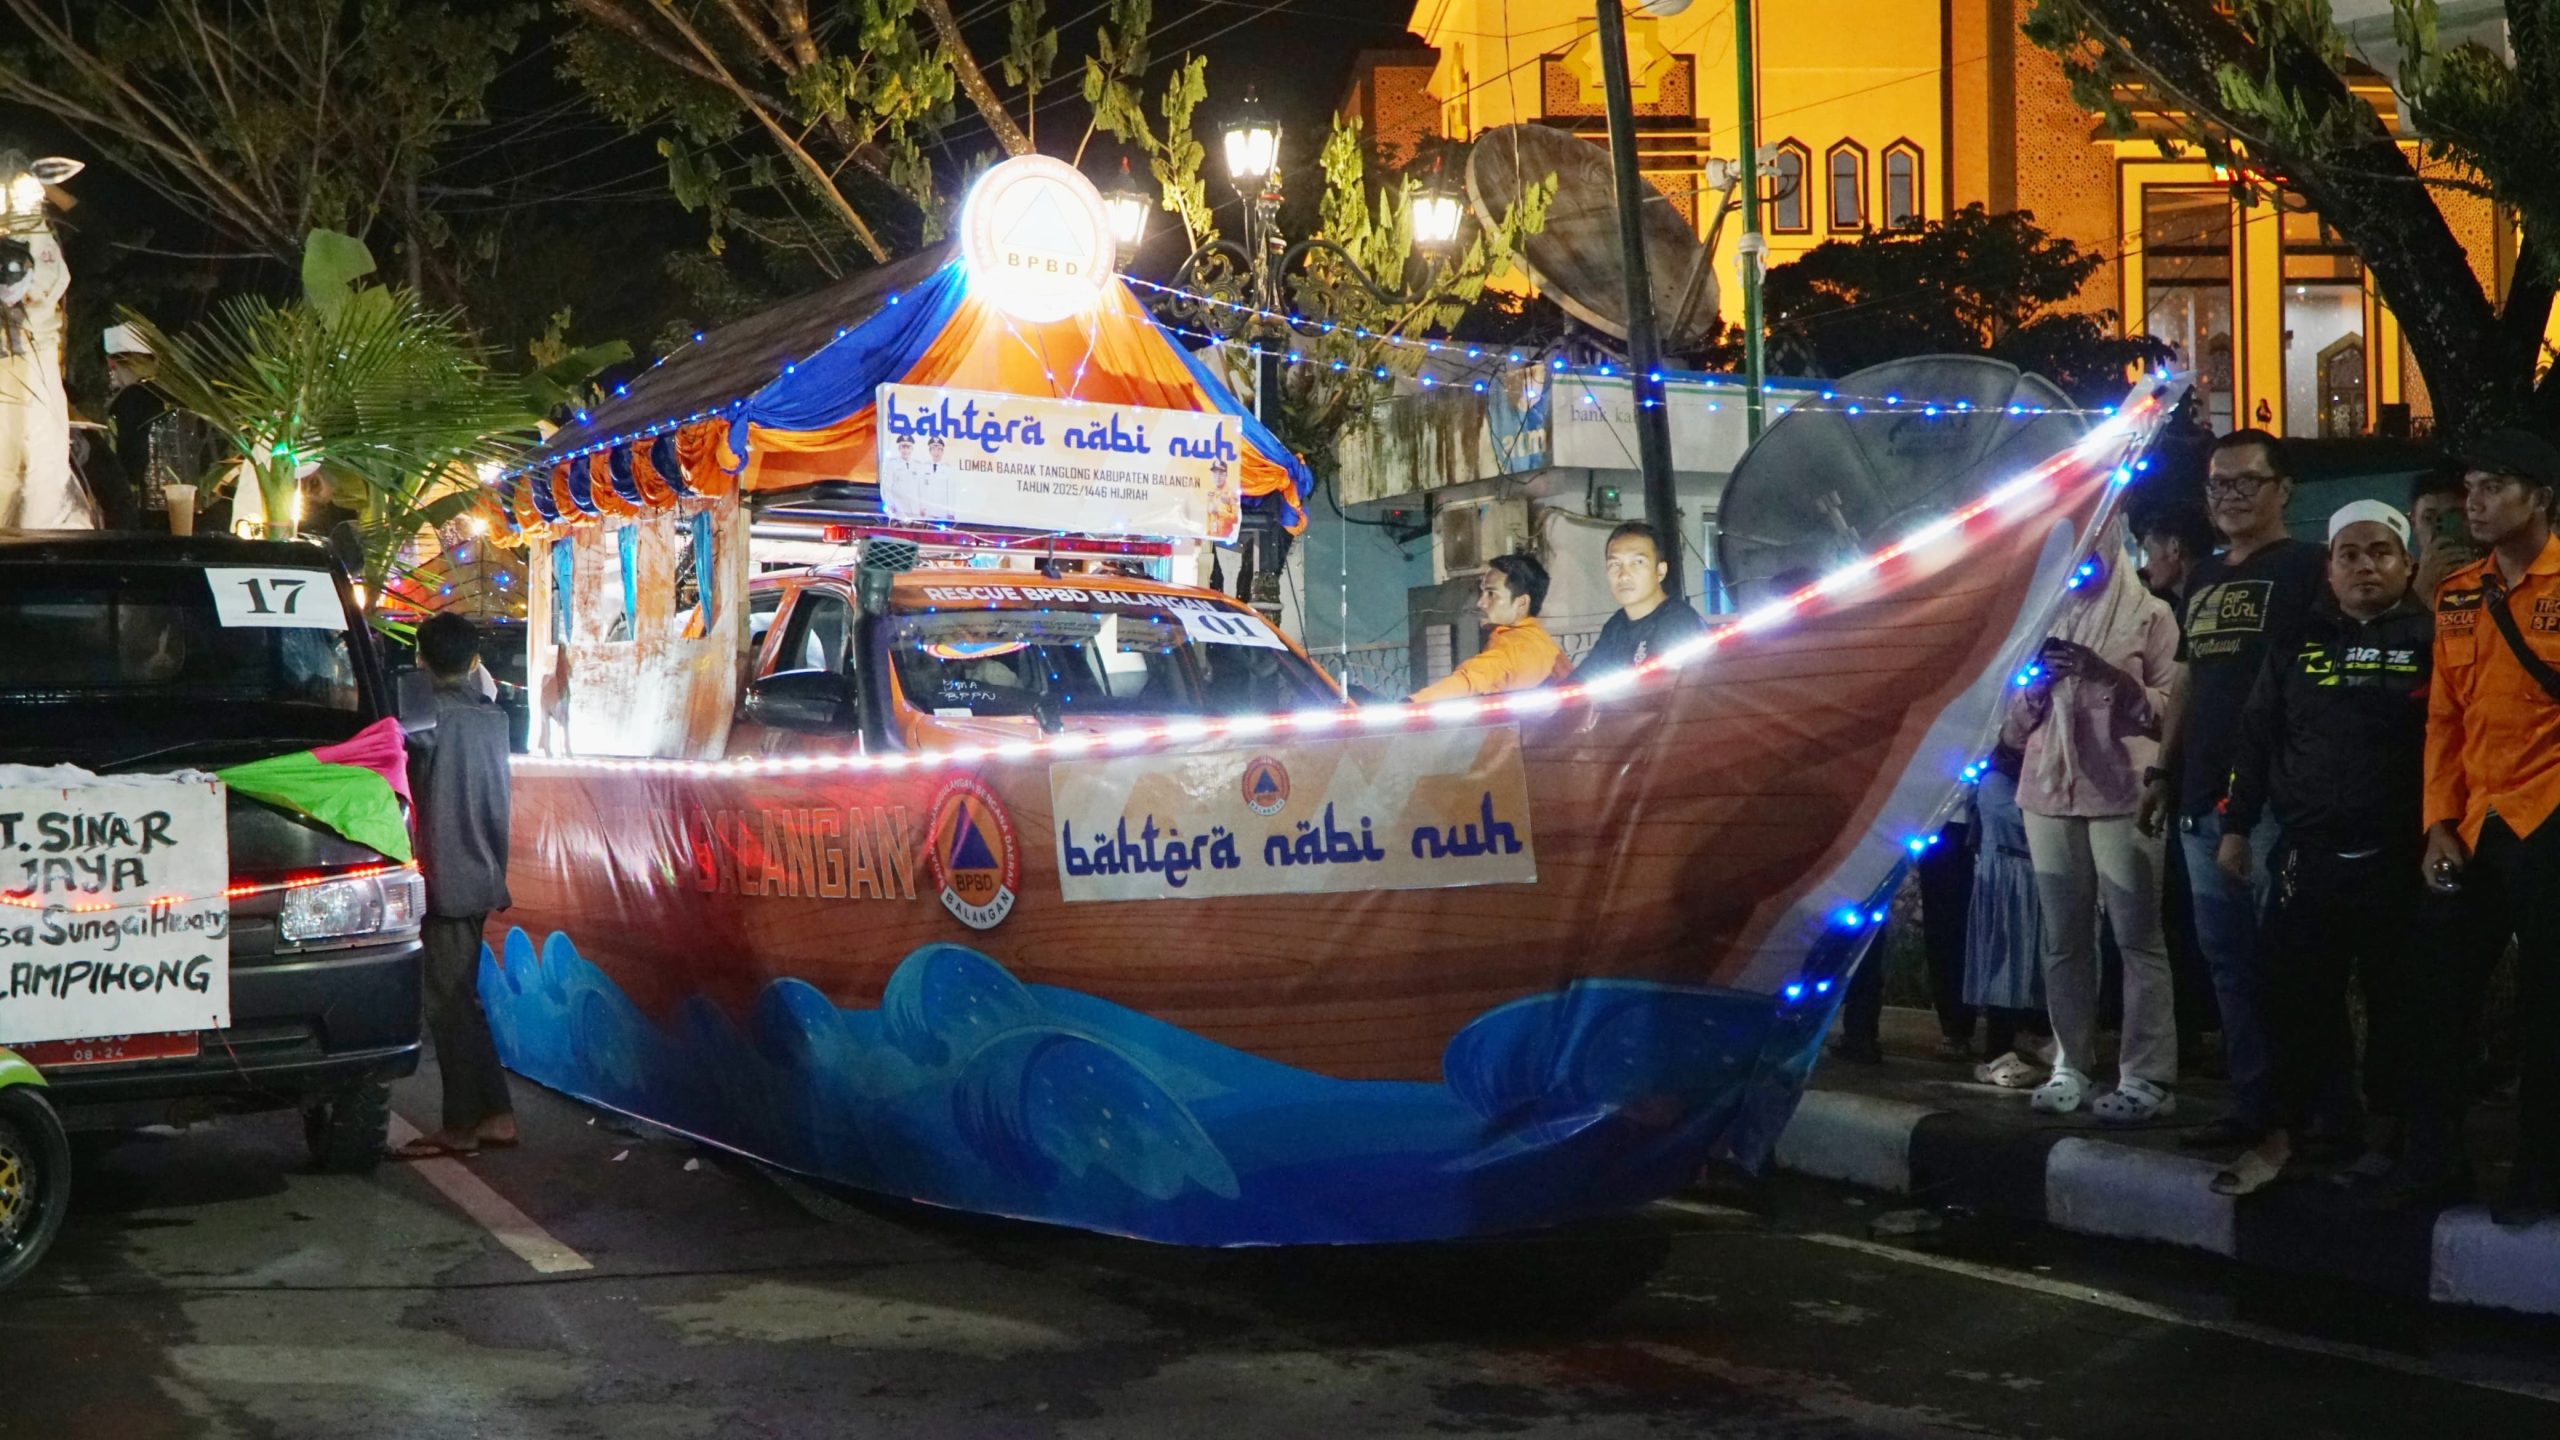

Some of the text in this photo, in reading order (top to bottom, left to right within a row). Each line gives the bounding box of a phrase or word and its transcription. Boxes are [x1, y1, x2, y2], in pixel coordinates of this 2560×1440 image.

[1008, 252, 1078, 276] BPBD
[1570, 404, 1607, 422] bank
[1169, 421, 1238, 462] nuh
[959, 459, 1201, 489] LOMBA BAARAK TANGLONG KABUPATEN BALANGAN
[1016, 480, 1149, 501] TAHUN 2025/1446 HIJRIAH
[238, 578, 306, 614] 17
[923, 586, 1216, 613] RESCUE BPBD BALANGAN
[2221, 603, 2259, 618] CURL
[2223, 590, 2249, 605] RIP
[1196, 614, 1259, 638] 01
[38, 808, 178, 854] SINAR
[975, 784, 1008, 833] BENCANA
[1004, 835, 1015, 887] DAERAH
[1411, 791, 1523, 859] nuh
[3, 854, 149, 898] JAYA
[955, 874, 993, 891] BPBD
[946, 892, 1010, 923] BALANGAN
[40, 904, 147, 951] Sungai
